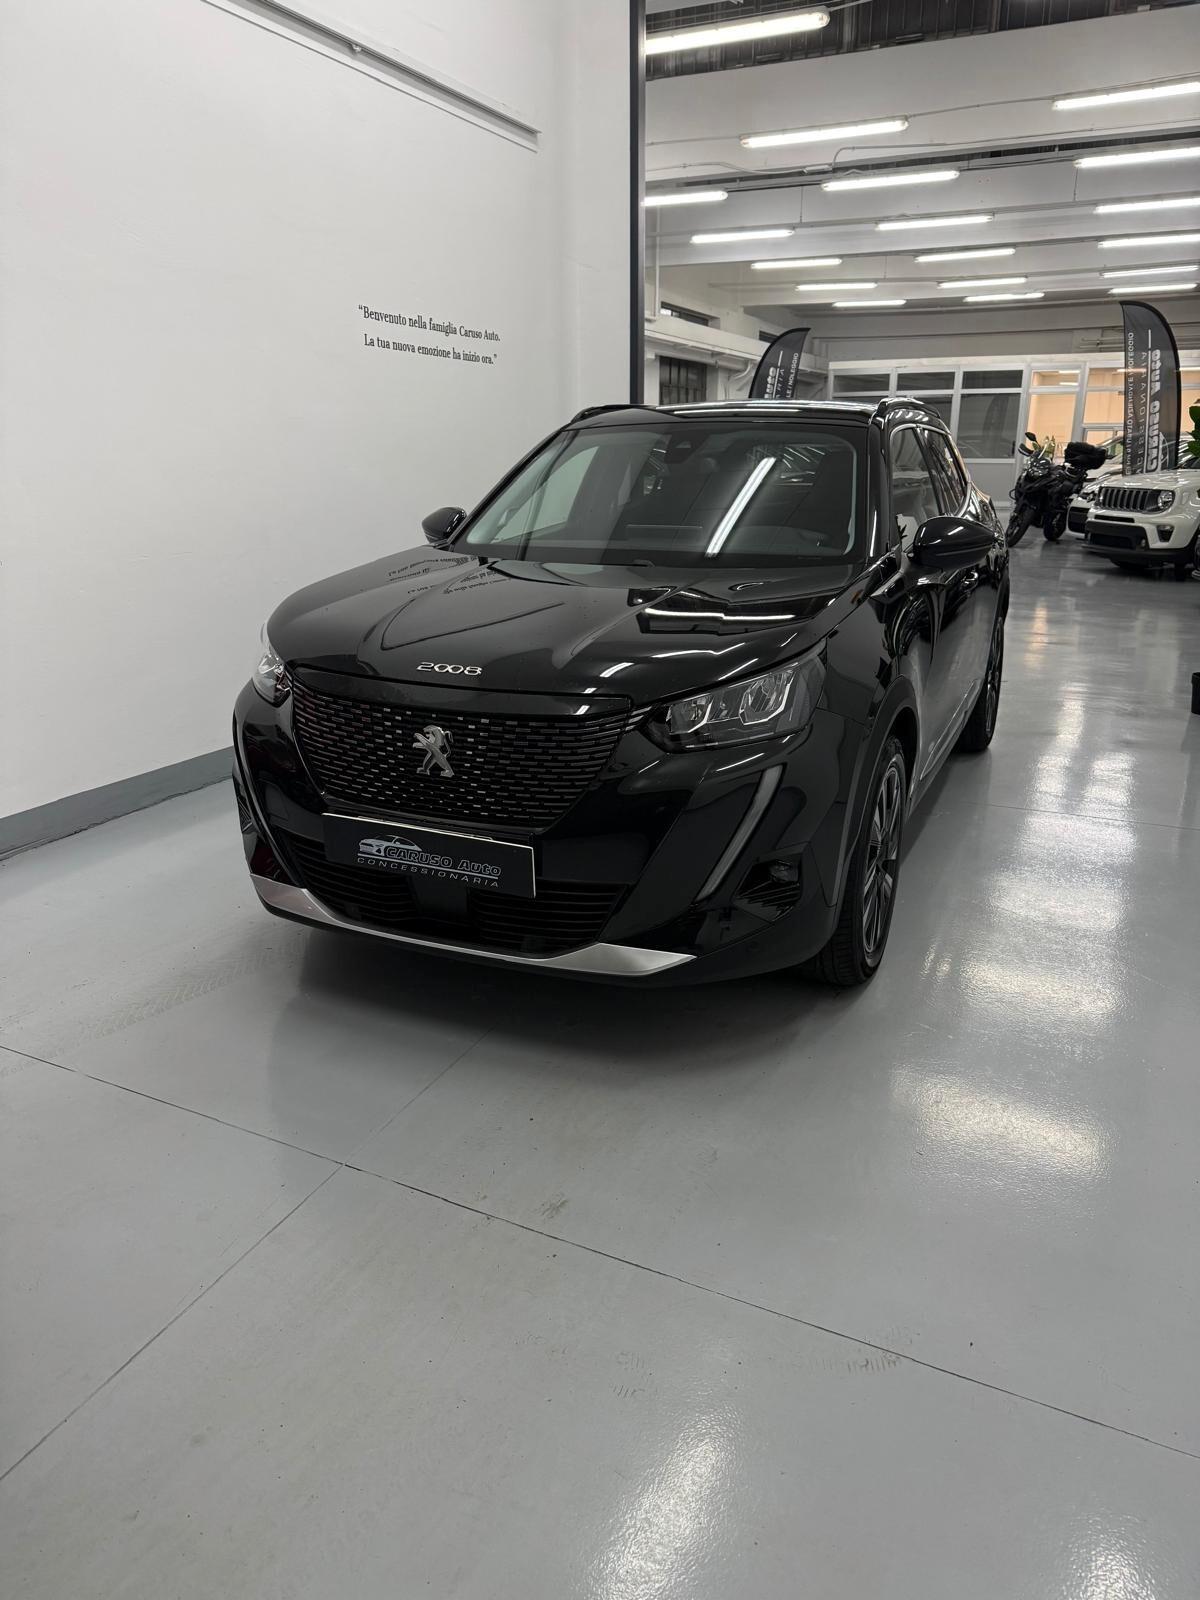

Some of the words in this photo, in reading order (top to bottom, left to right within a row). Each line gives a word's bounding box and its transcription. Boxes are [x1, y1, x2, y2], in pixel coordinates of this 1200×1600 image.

[408, 315, 427, 330] nella
[429, 317, 457, 337] famiglia
[459, 325, 482, 340] Caruso
[483, 329, 501, 342] Auto.
[364, 333, 375, 347] La
[376, 336, 391, 350] tua
[392, 341, 416, 353] nuova
[417, 344, 451, 359] emozione
[452, 347, 461, 360] ha
[462, 350, 480, 363] inizio
[416, 661, 482, 676] 2008
[357, 857, 499, 888] CONCESSIONARIA
[385, 846, 453, 868] CARUSO
[457, 859, 502, 877] Auto
